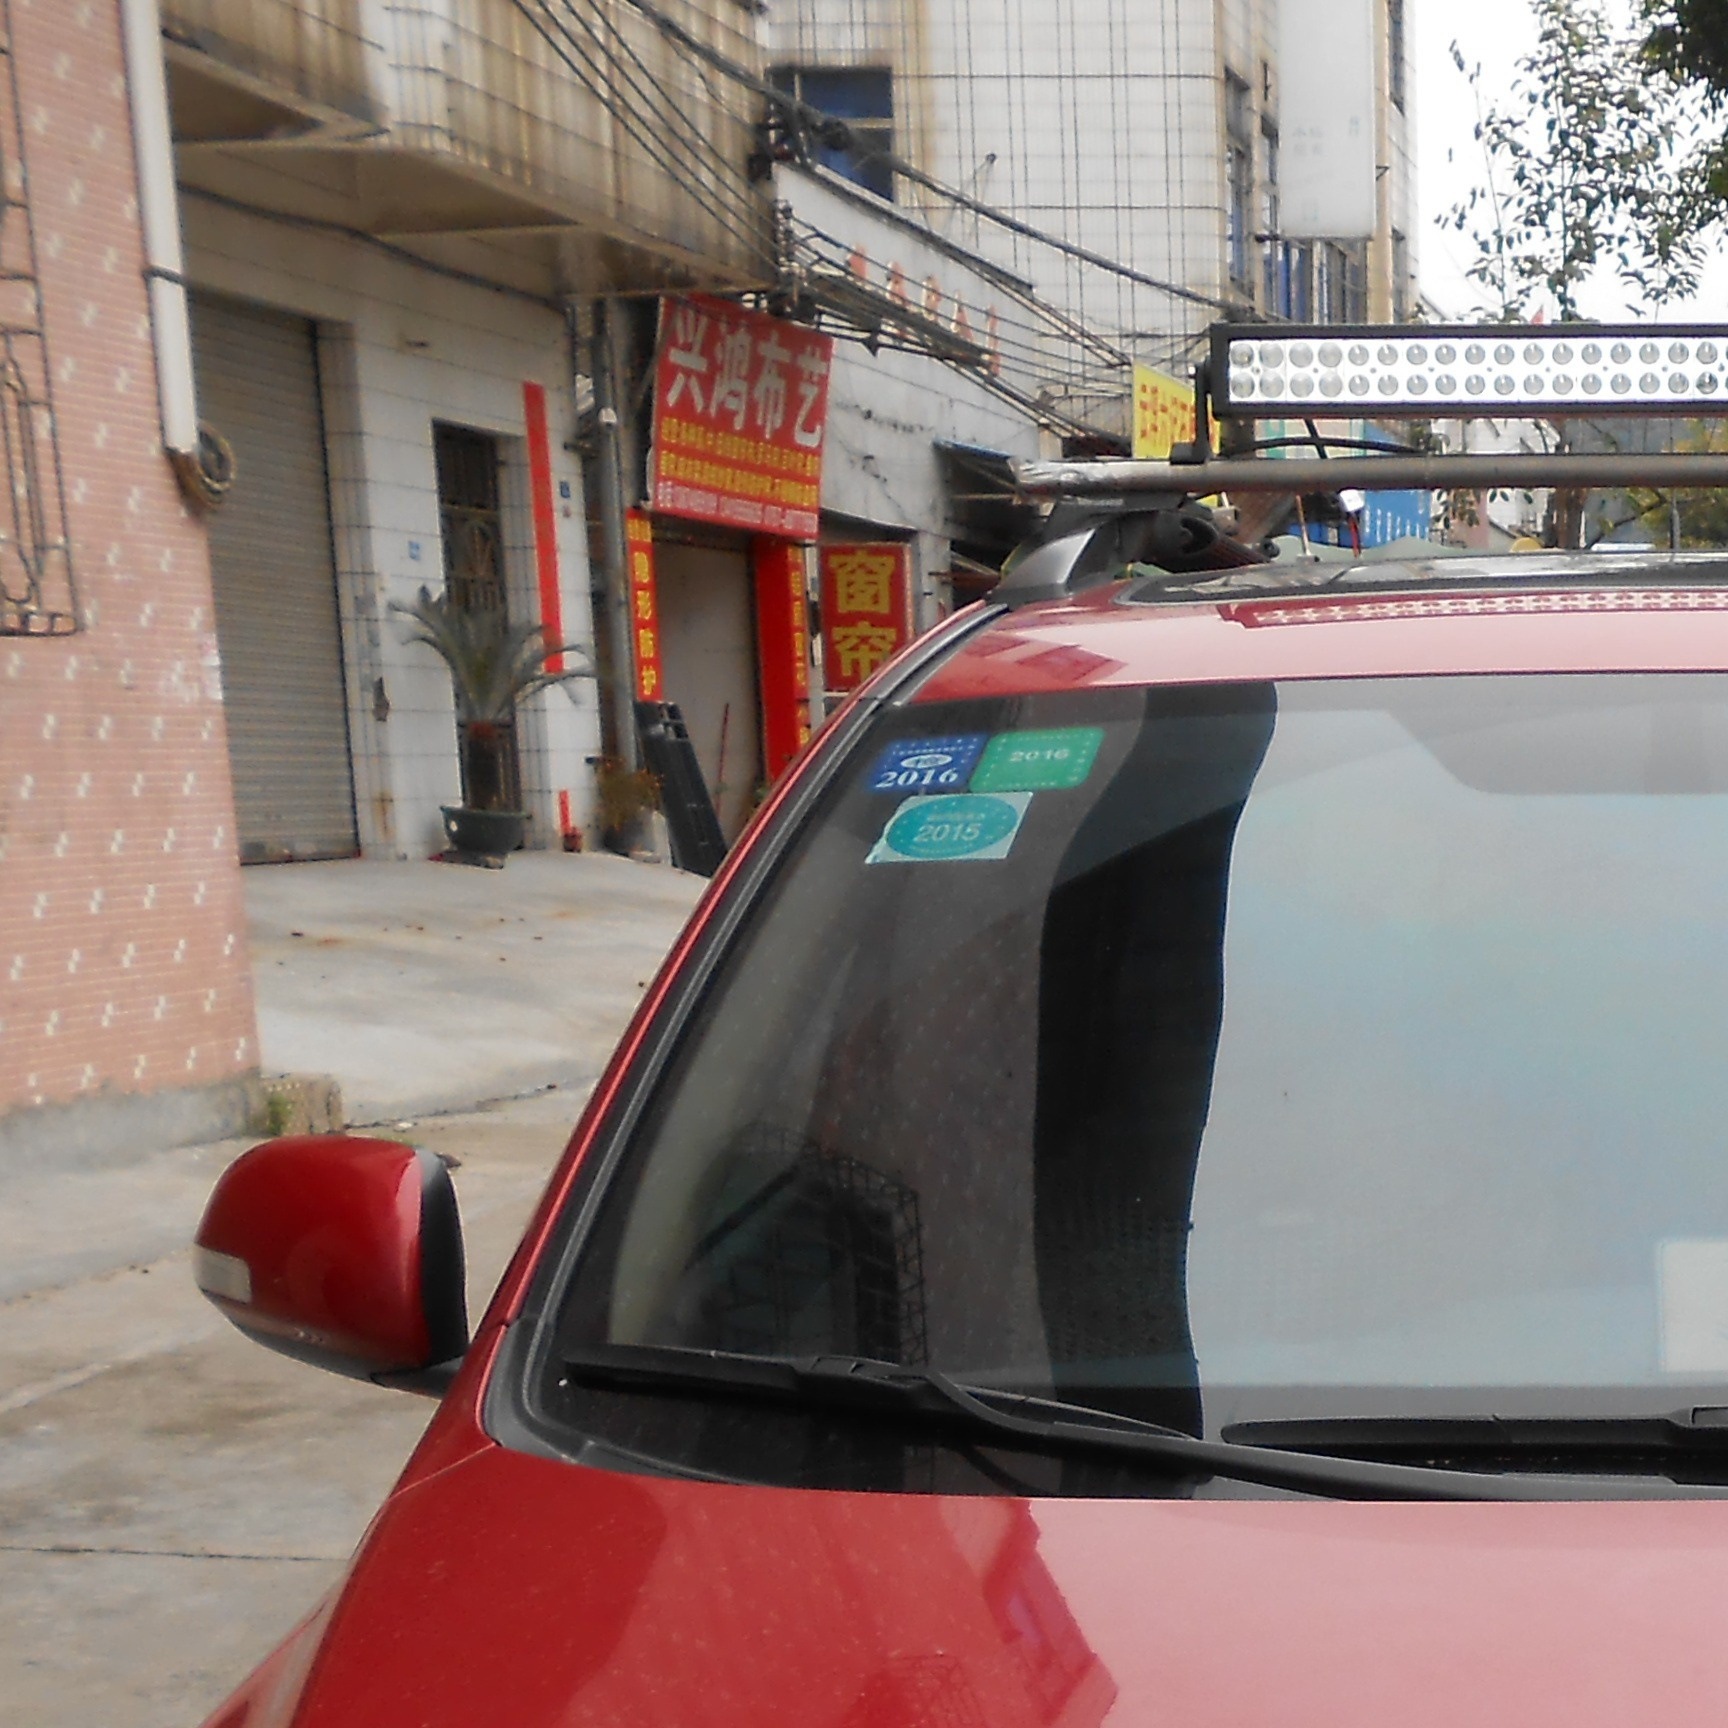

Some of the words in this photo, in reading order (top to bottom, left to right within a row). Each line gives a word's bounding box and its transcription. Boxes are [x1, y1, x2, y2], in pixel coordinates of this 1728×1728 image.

[666, 309, 828, 448] 兴鸿布艺
[828, 551, 897, 682] 窗帘
[1009, 748, 1071, 763] 2016
[875, 767, 959, 788] 2016
[912, 823, 983, 842] 2015
